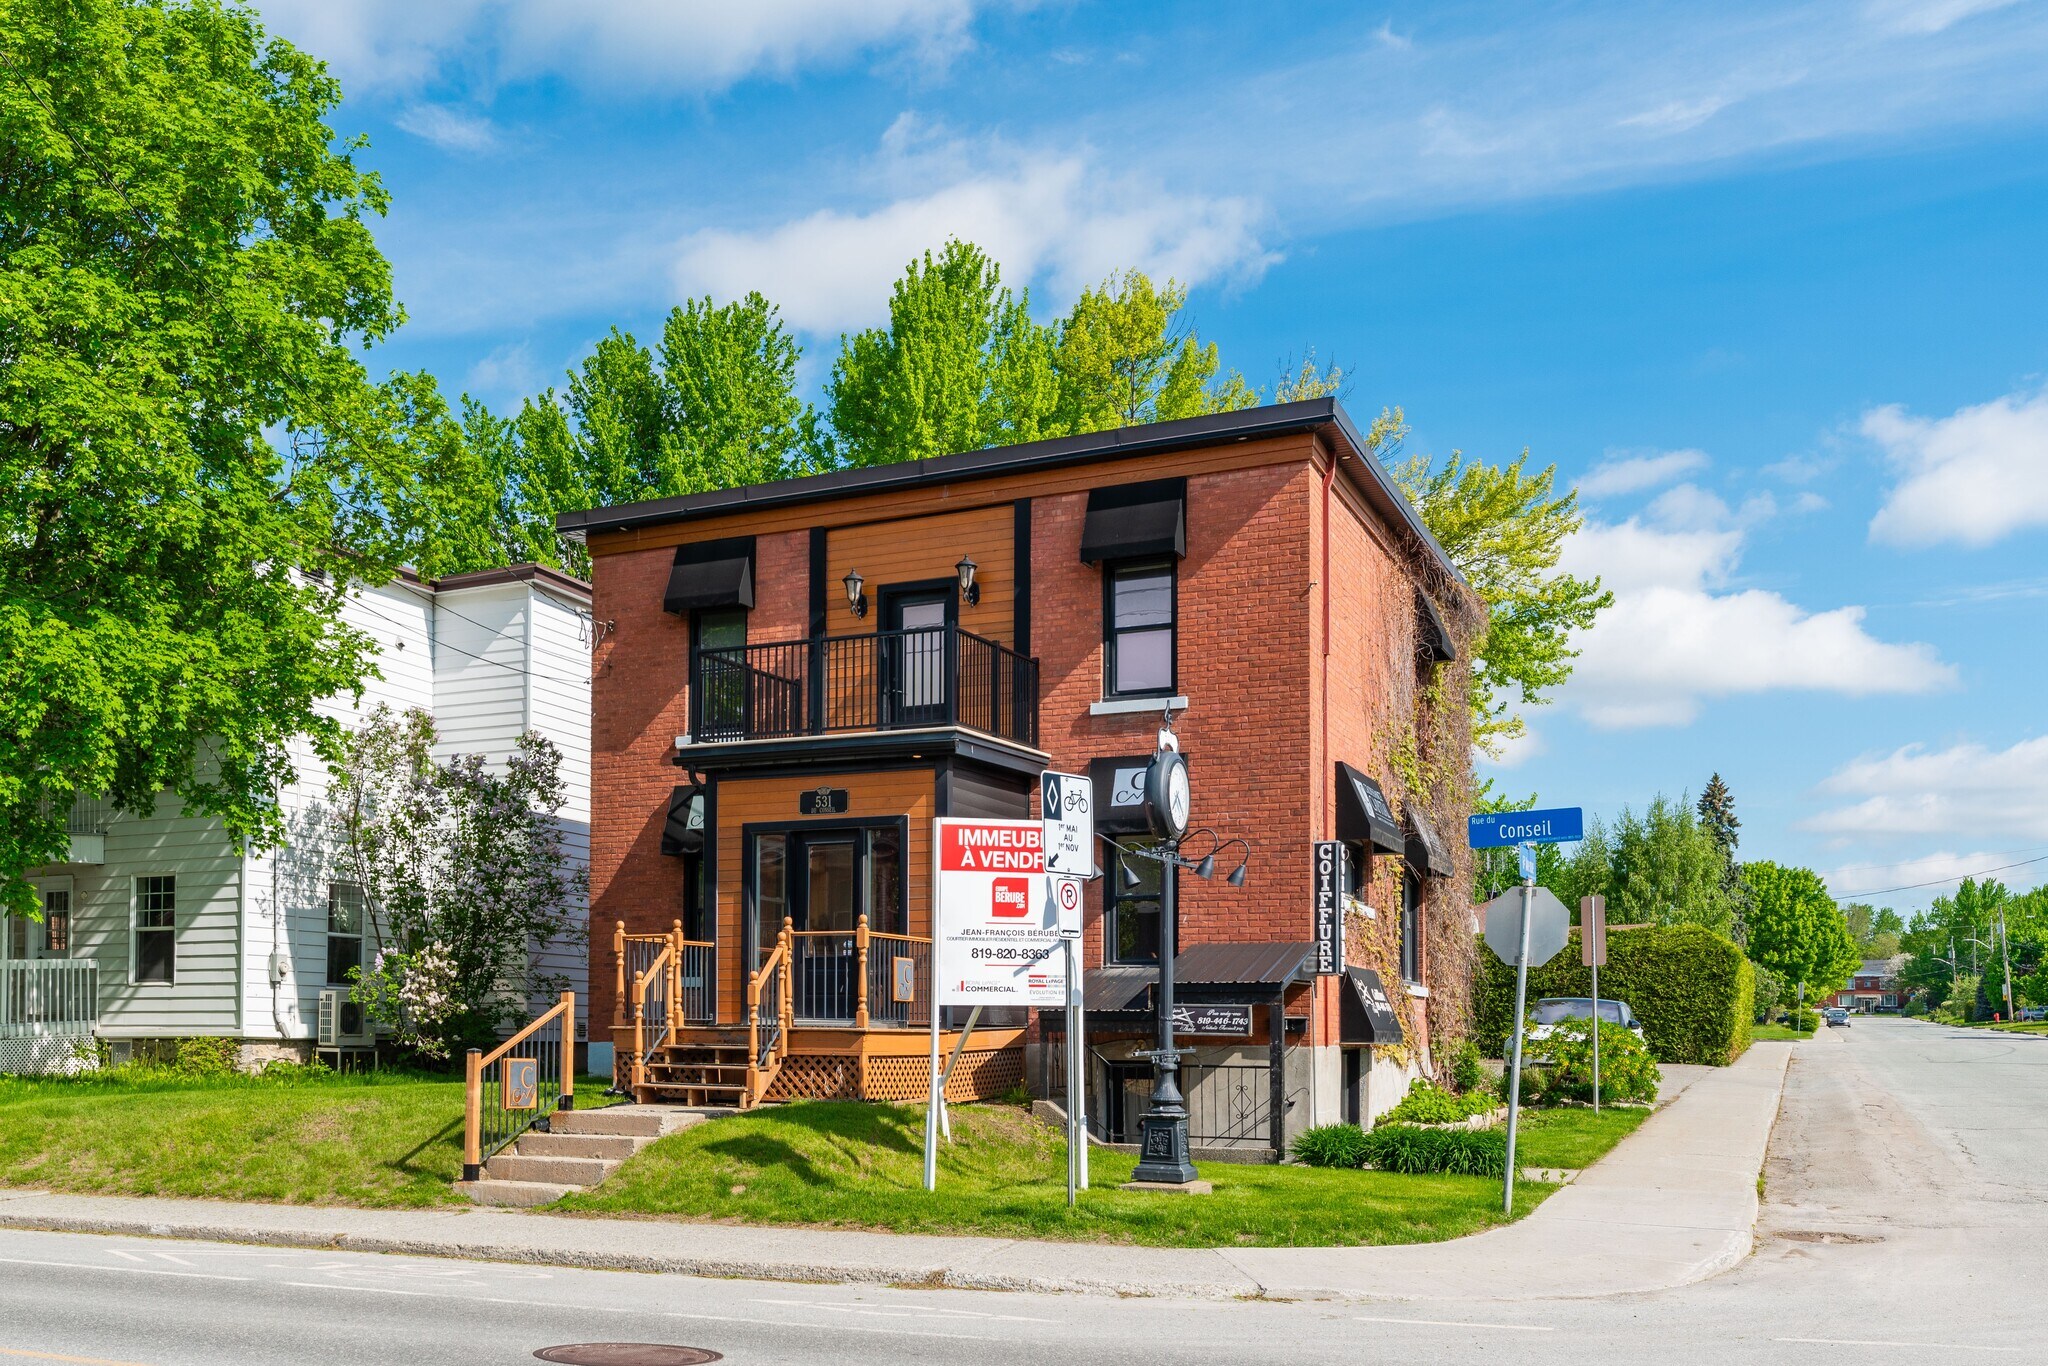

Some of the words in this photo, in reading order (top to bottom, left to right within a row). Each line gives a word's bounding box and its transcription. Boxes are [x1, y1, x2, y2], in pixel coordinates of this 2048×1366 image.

[815, 795, 832, 808] 531
[1471, 816, 1485, 825] Rue
[1486, 815, 1496, 824] du
[1066, 825, 1078, 833] MAI
[1499, 820, 1552, 839] Conseil
[1063, 833, 1073, 842] AU
[1065, 844, 1079, 852] NOV
[960, 845, 976, 867] À
[1318, 844, 1333, 973] COIFFURE
[960, 928, 1025, 938] JEAN-FRANÇOIS
[971, 948, 1050, 960] 819-820-8363
[1196, 1017, 1249, 1026] 819-446-1743
